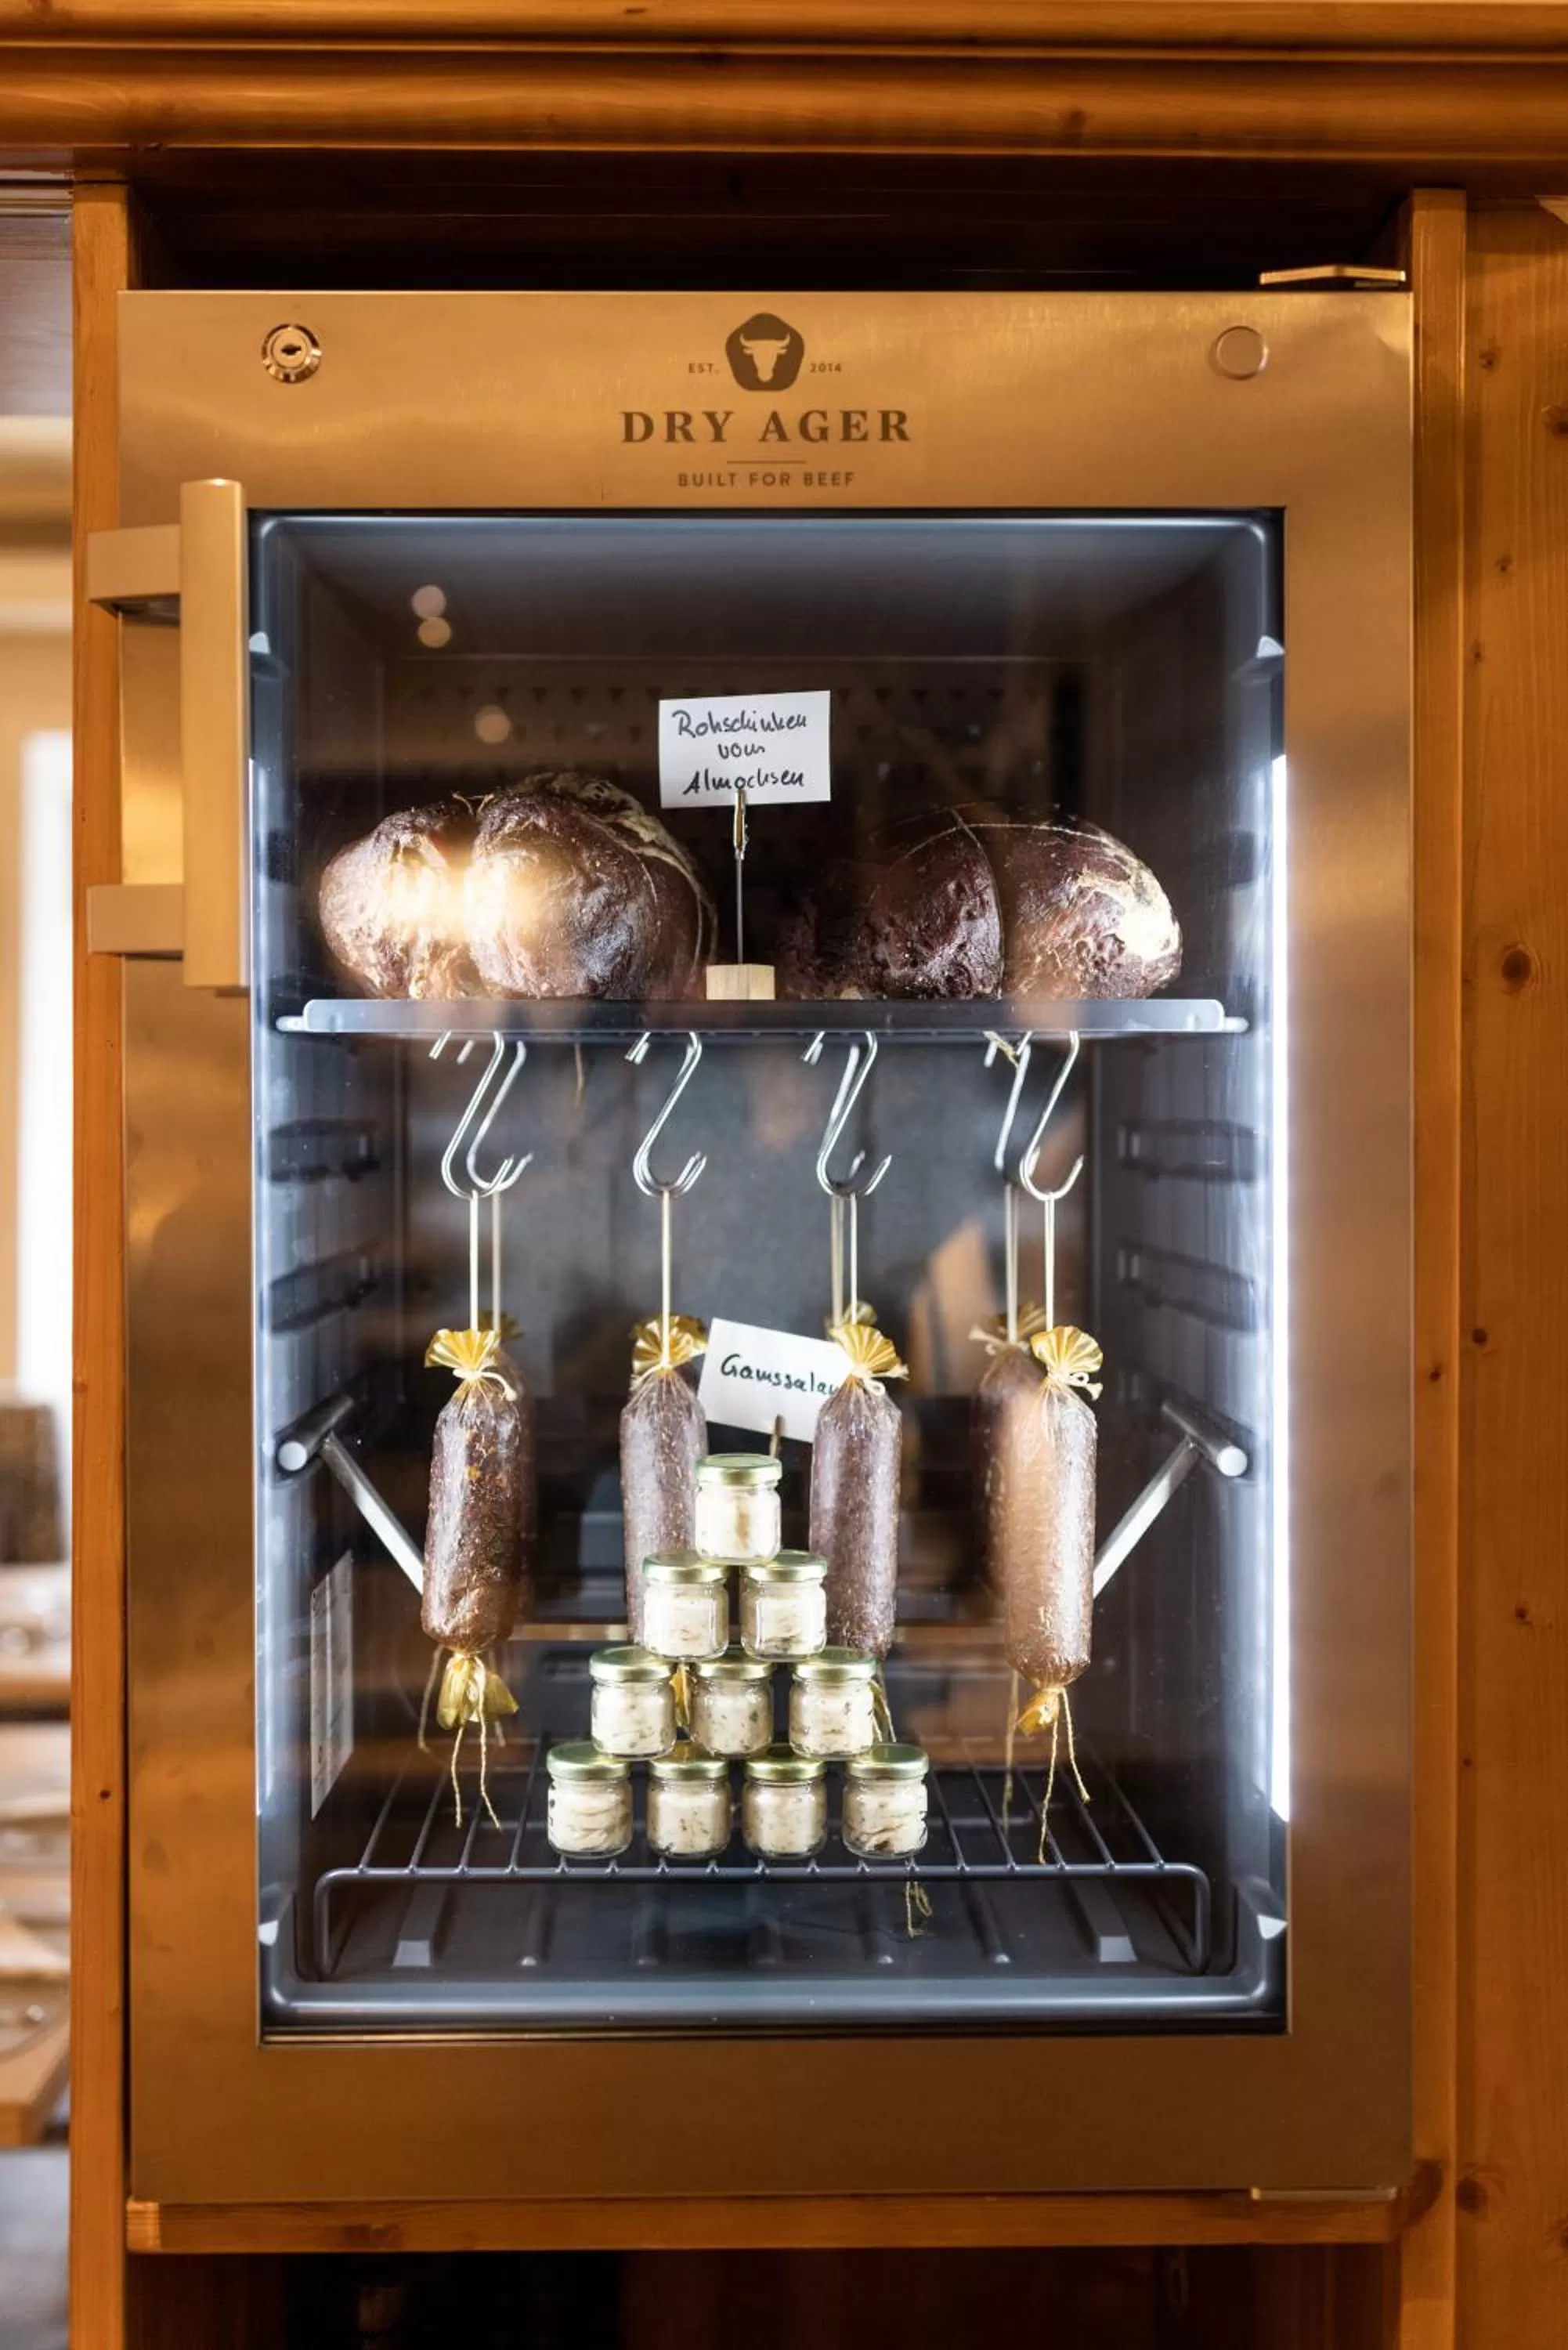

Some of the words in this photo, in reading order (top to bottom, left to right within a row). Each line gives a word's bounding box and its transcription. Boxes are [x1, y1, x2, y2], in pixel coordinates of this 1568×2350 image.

[688, 363, 720, 374] EST.
[810, 362, 841, 374] 2014
[620, 410, 735, 443] DRY
[758, 409, 912, 443] AGER
[677, 472, 738, 486] BUILT
[749, 472, 791, 486] FOR
[803, 472, 855, 486] BEEF
[671, 709, 807, 738] Rohschinken
[717, 743, 765, 759] vom
[682, 768, 804, 795] Almochsen
